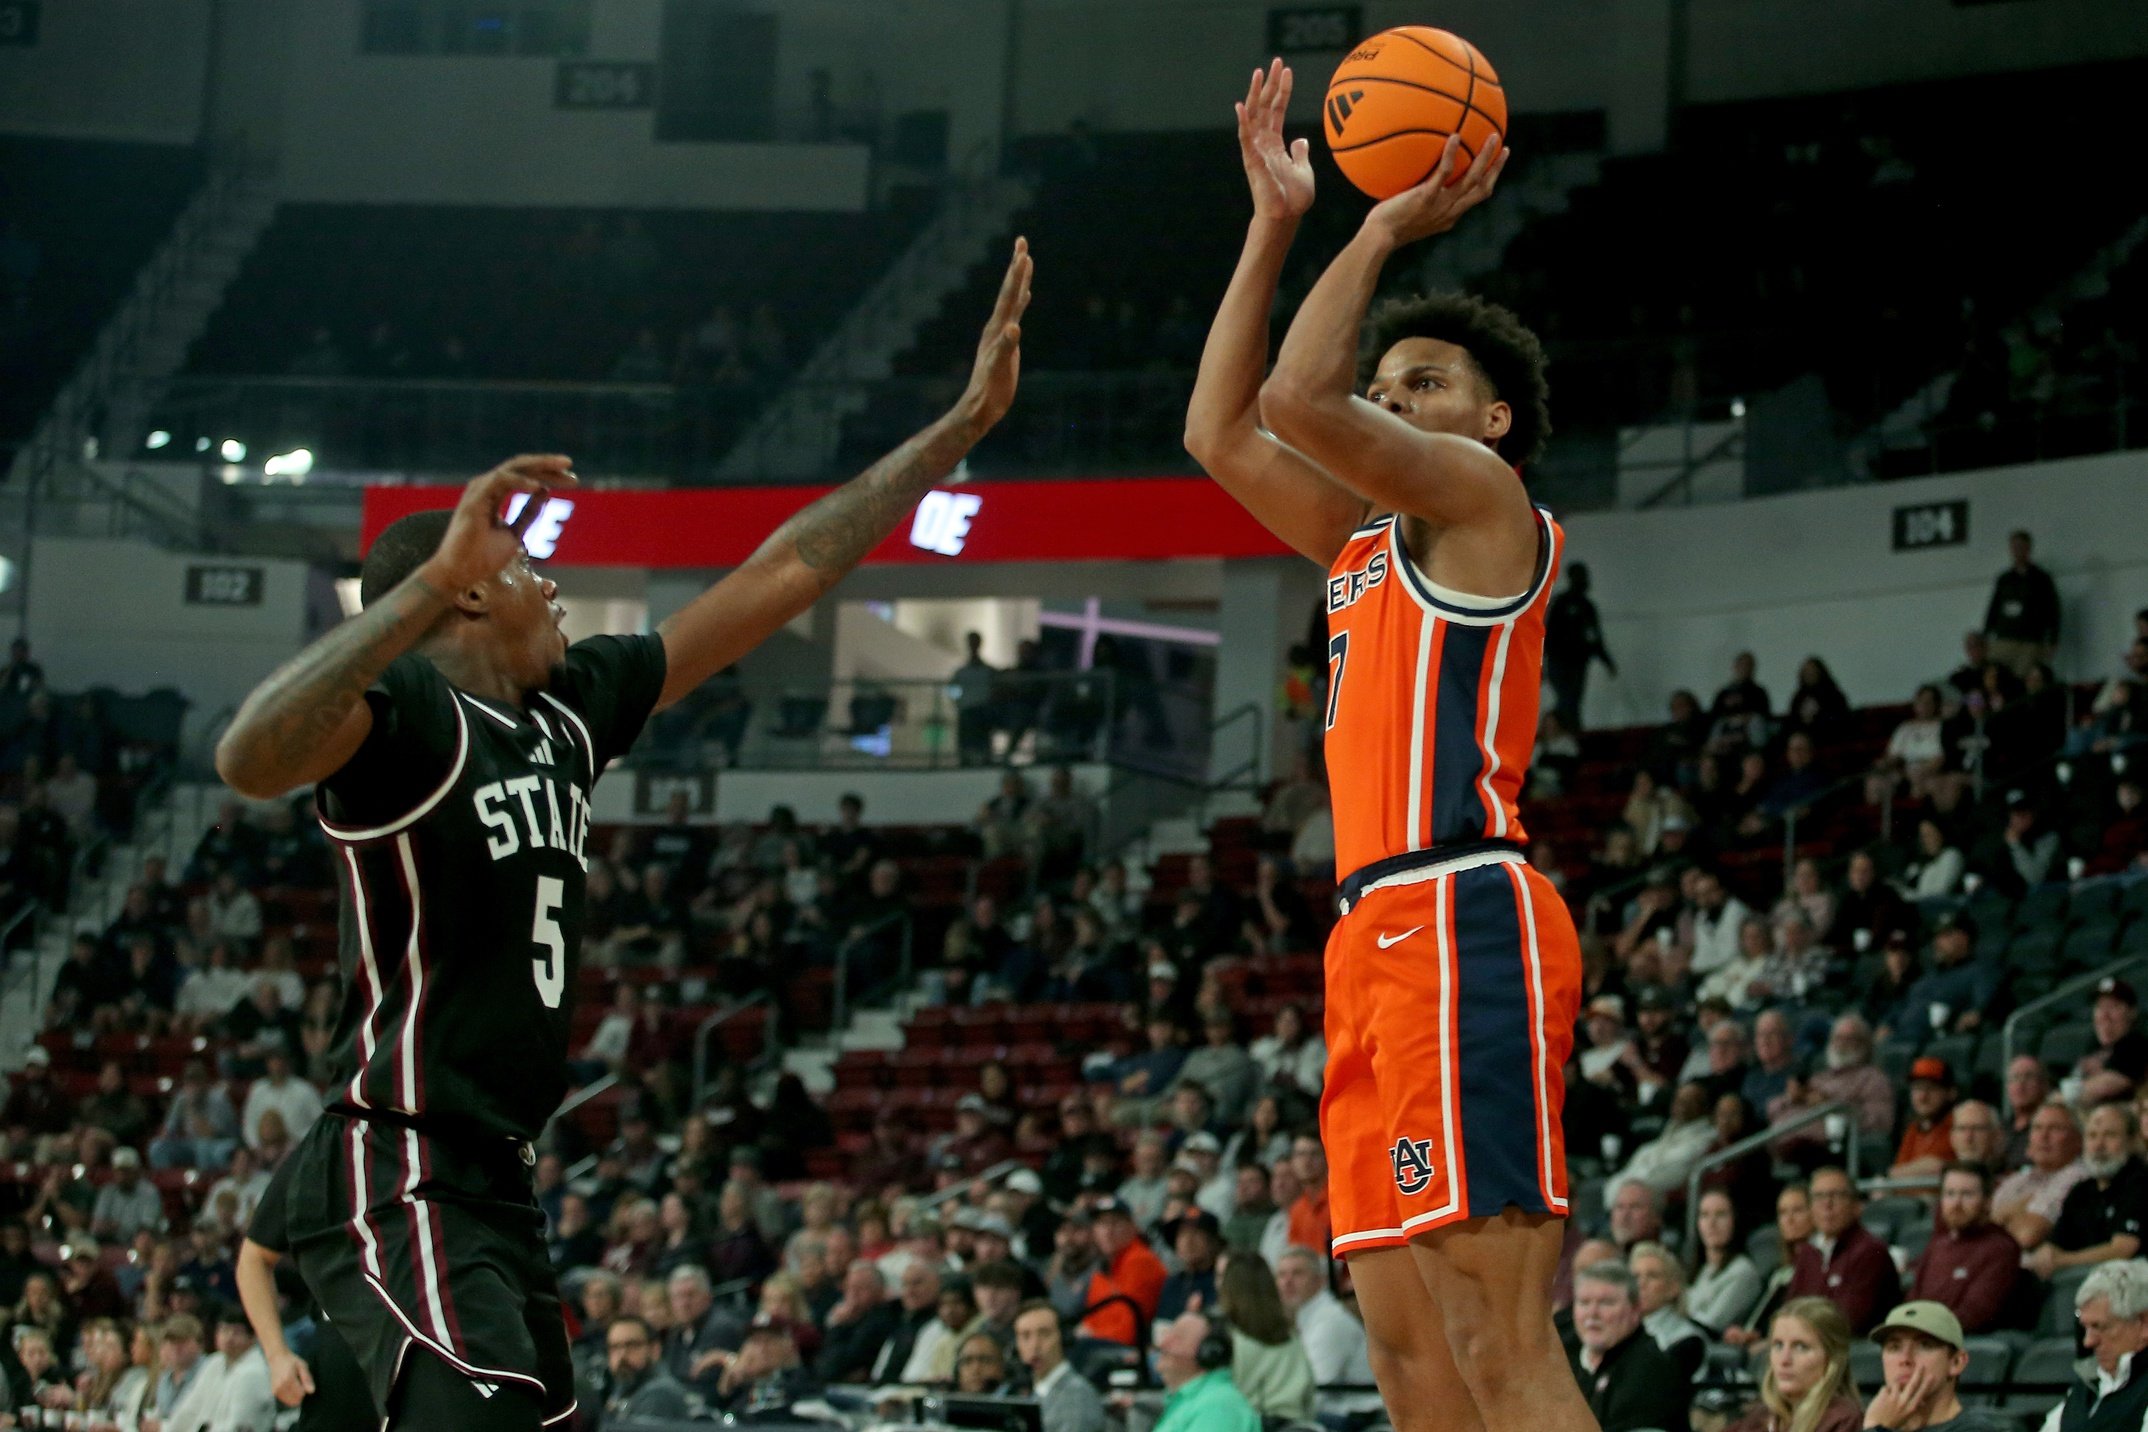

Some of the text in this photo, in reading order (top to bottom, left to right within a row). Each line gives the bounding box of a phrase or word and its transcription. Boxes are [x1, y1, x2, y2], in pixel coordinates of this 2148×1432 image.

[1326, 629, 1350, 732] 7
[473, 774, 591, 873] STATE
[532, 875, 565, 1009] 5
